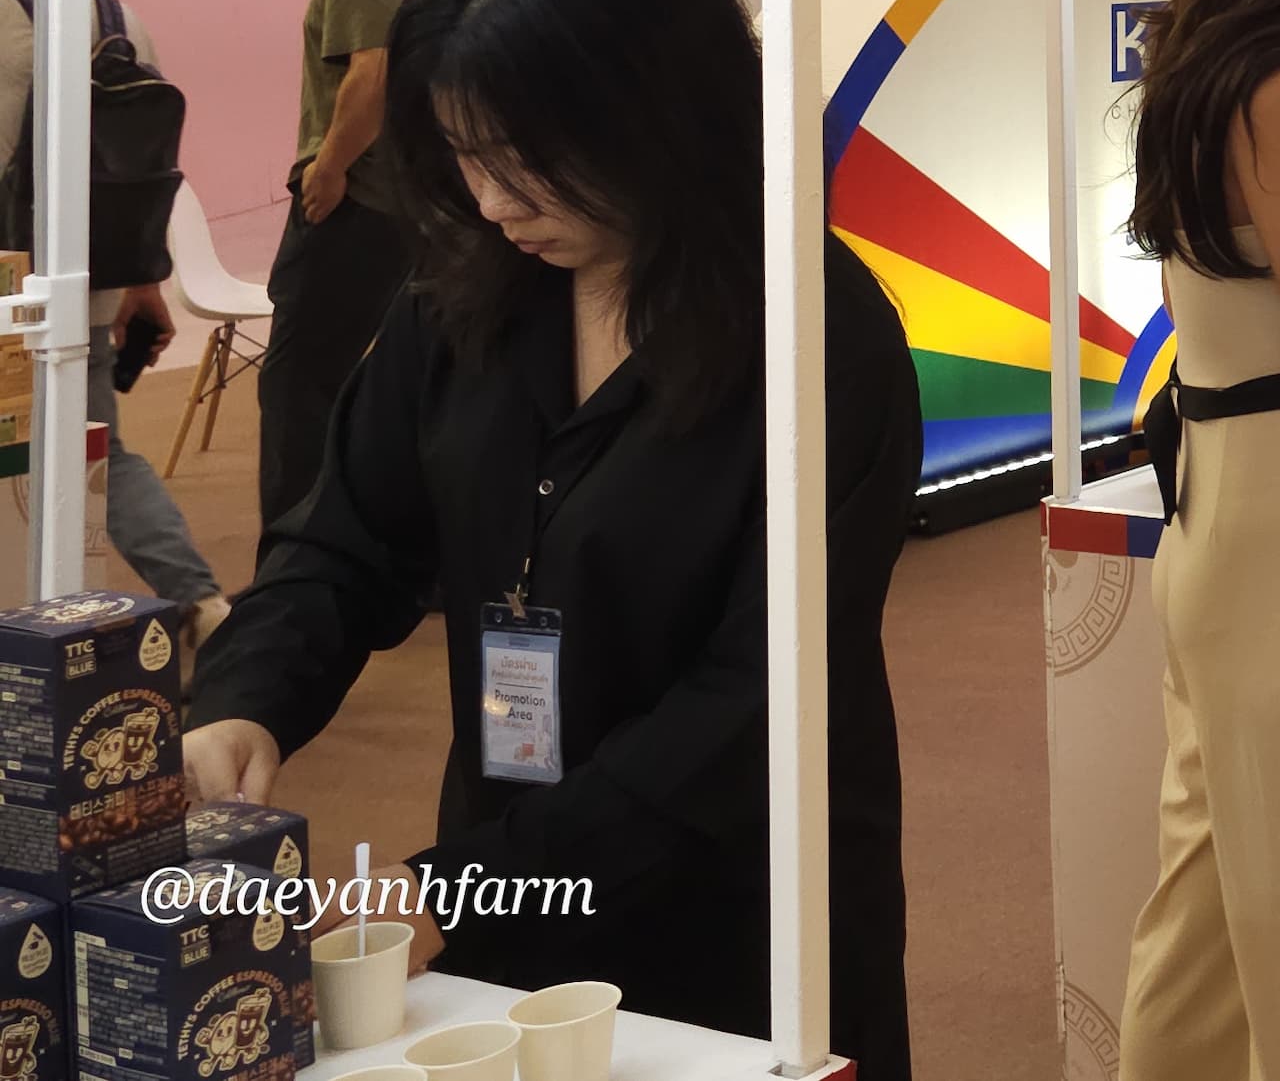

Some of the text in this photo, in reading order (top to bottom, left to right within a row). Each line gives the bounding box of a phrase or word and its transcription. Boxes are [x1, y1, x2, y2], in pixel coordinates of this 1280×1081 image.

[65, 638, 96, 658] TTC
[68, 660, 96, 677] BLUE
[494, 689, 546, 708] Promotion
[507, 705, 533, 721] Area
[63, 725, 84, 771] TETHYS
[80, 691, 122, 725] COFFEE
[123, 688, 173, 715] ESPRESSO
[180, 924, 210, 946] TTC
[183, 946, 210, 964] BLUE
[177, 1013, 198, 1061] TETHYS
[194, 974, 236, 1013] COFFEE
[235, 969, 284, 993] ESPRESSO
